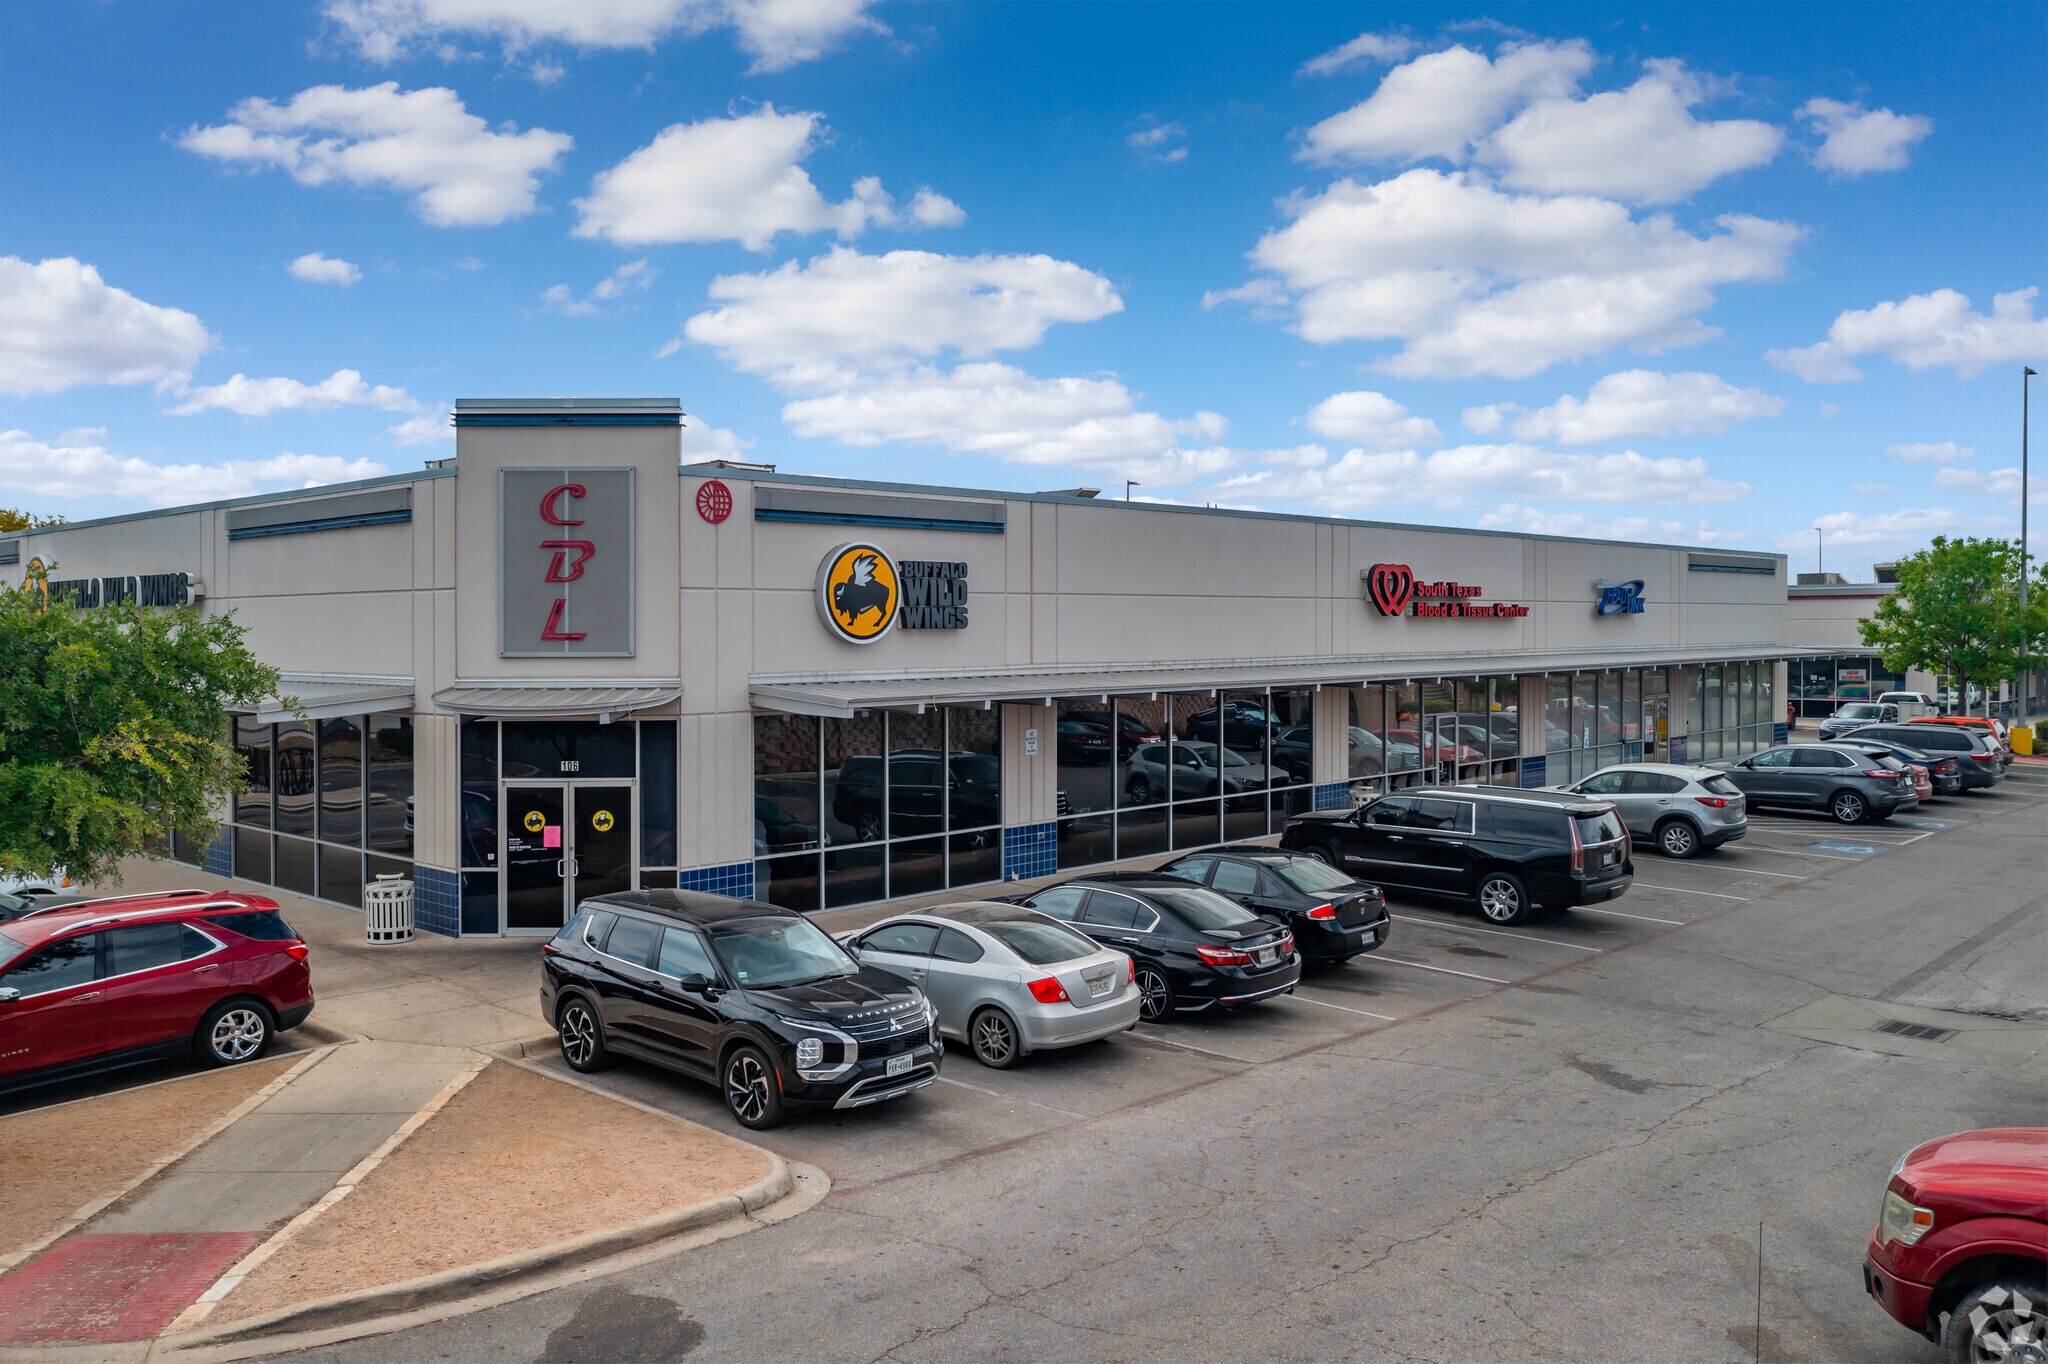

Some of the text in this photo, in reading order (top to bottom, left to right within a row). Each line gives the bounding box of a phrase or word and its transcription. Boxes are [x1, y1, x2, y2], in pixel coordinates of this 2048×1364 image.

[539, 483, 597, 641] CBL
[902, 561, 968, 579] BUFFALO
[102, 576, 137, 607] WILD
[140, 572, 189, 607] WINGS
[903, 579, 968, 607] WILD
[1417, 581, 1482, 598] South Texas
[903, 607, 969, 629] WINGS
[1417, 602, 1529, 618] Blood & Tissue Center
[562, 761, 578, 771] 106
[847, 1000, 917, 1019] OUTLANDER
